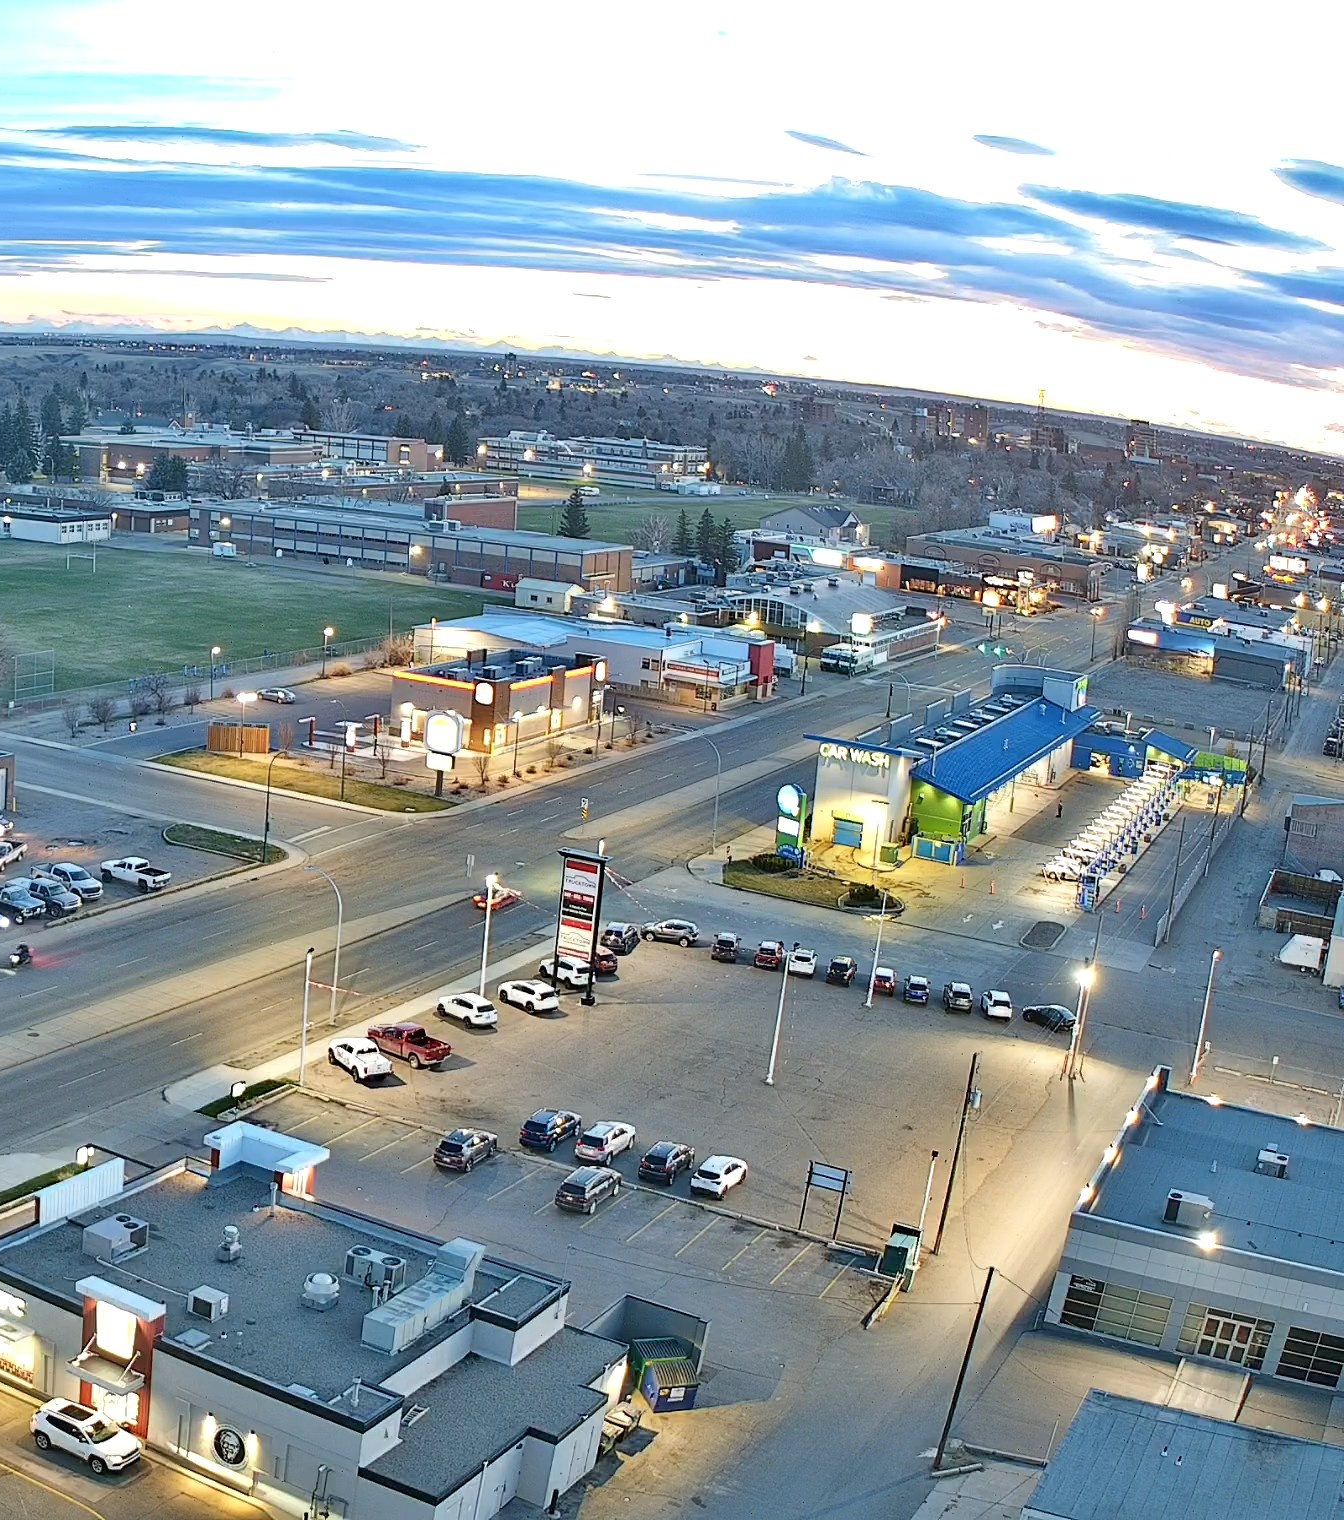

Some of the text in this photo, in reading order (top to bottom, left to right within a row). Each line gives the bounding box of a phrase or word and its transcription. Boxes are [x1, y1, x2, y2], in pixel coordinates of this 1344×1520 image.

[1189, 616, 1212, 627] AUTO
[819, 743, 890, 769] CAR WASH
